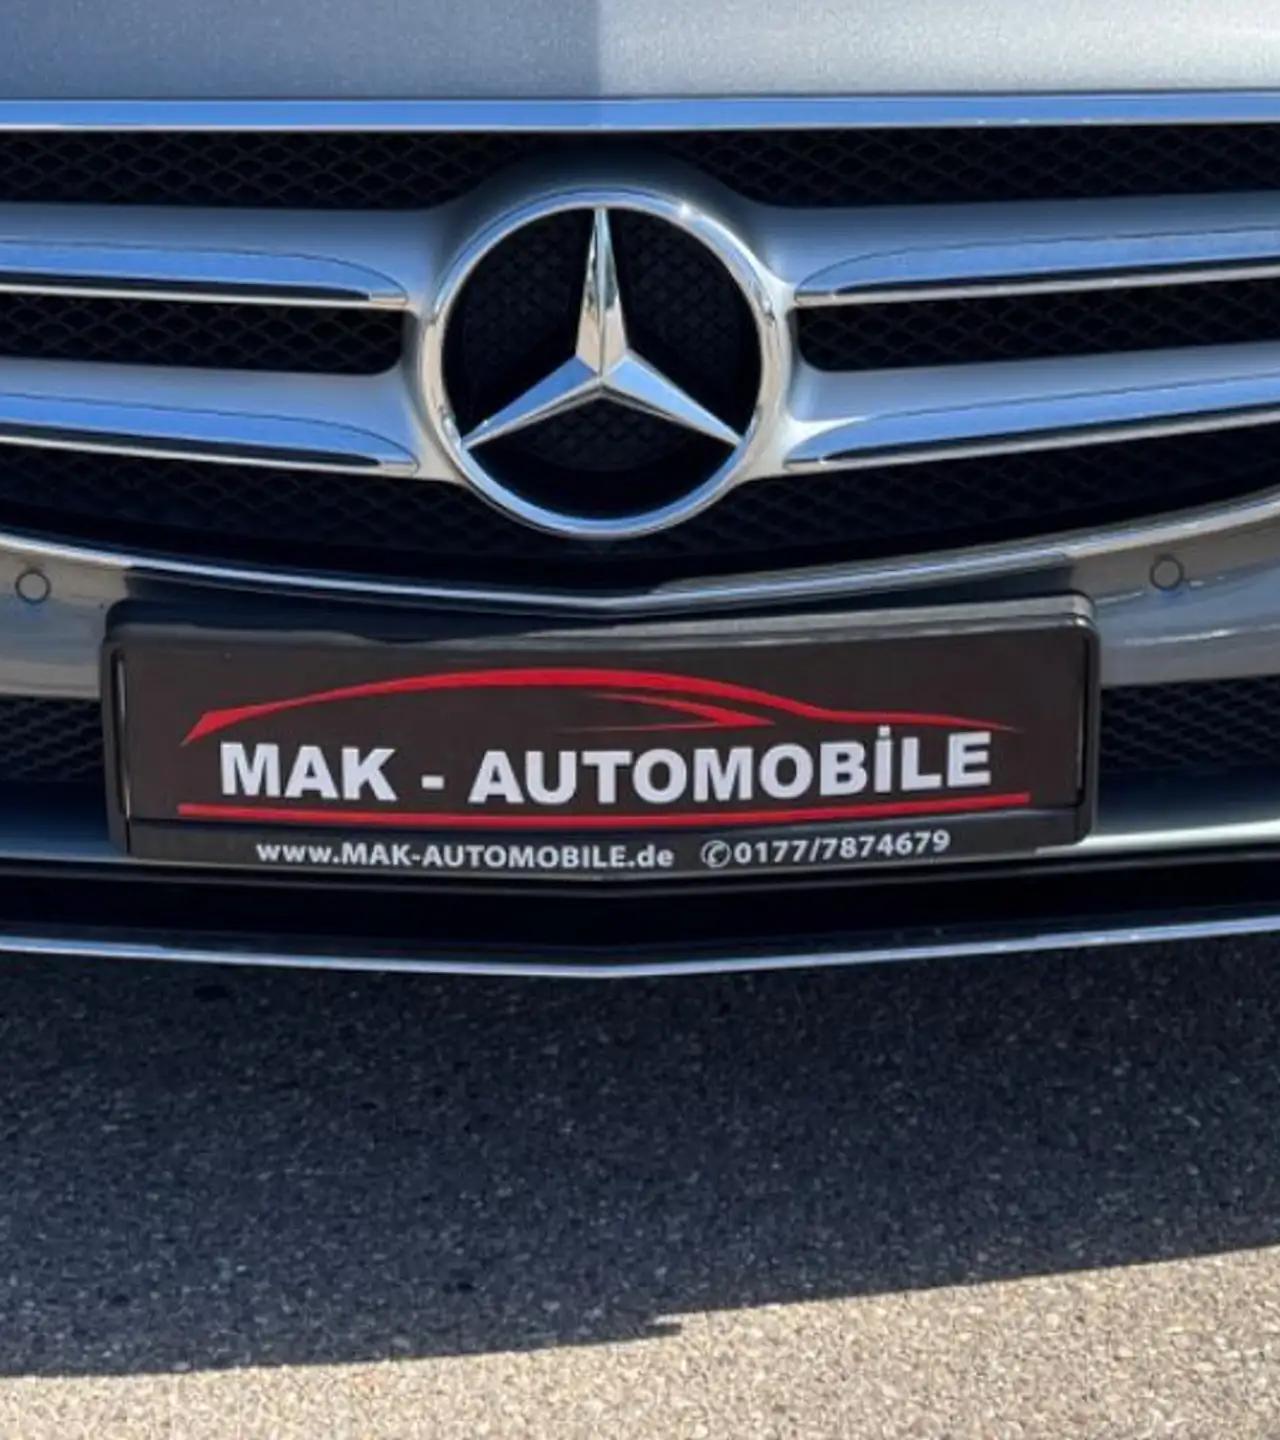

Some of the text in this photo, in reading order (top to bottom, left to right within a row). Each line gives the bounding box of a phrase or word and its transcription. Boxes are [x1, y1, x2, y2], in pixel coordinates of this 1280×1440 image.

[220, 741, 398, 802] MAK
[421, 775, 445, 790] -
[256, 841, 675, 869] www.MAK-AUTOMOBILE.de
